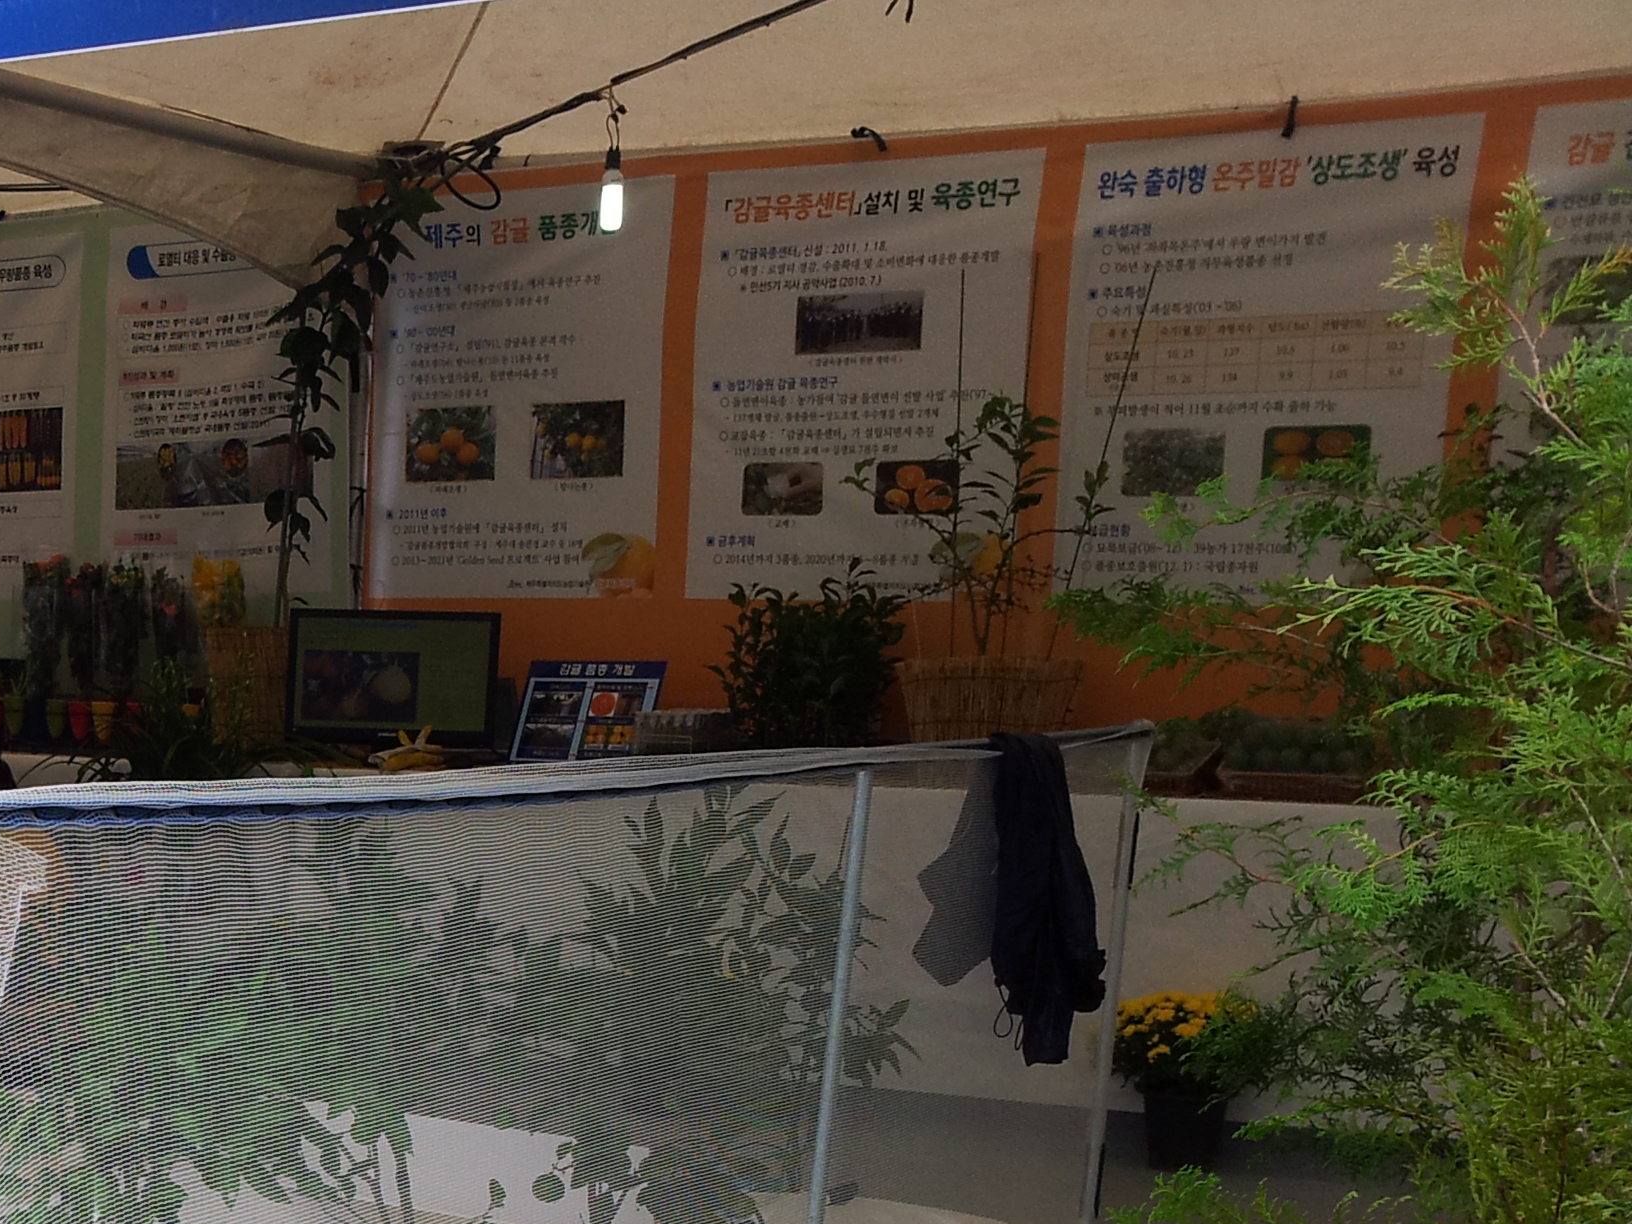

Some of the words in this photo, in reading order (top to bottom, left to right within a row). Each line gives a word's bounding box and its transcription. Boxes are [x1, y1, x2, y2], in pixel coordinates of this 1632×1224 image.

[1098, 171, 1137, 199] 완숙
[1144, 164, 1207, 197] 출하형
[1212, 156, 1302, 192] 온주밀감
[1413, 144, 1461, 177] 육성
[907, 187, 925, 212] 및
[931, 178, 1021, 211] 육종연구
[425, 221, 481, 250] 제주의
[490, 216, 531, 245] 감귤
